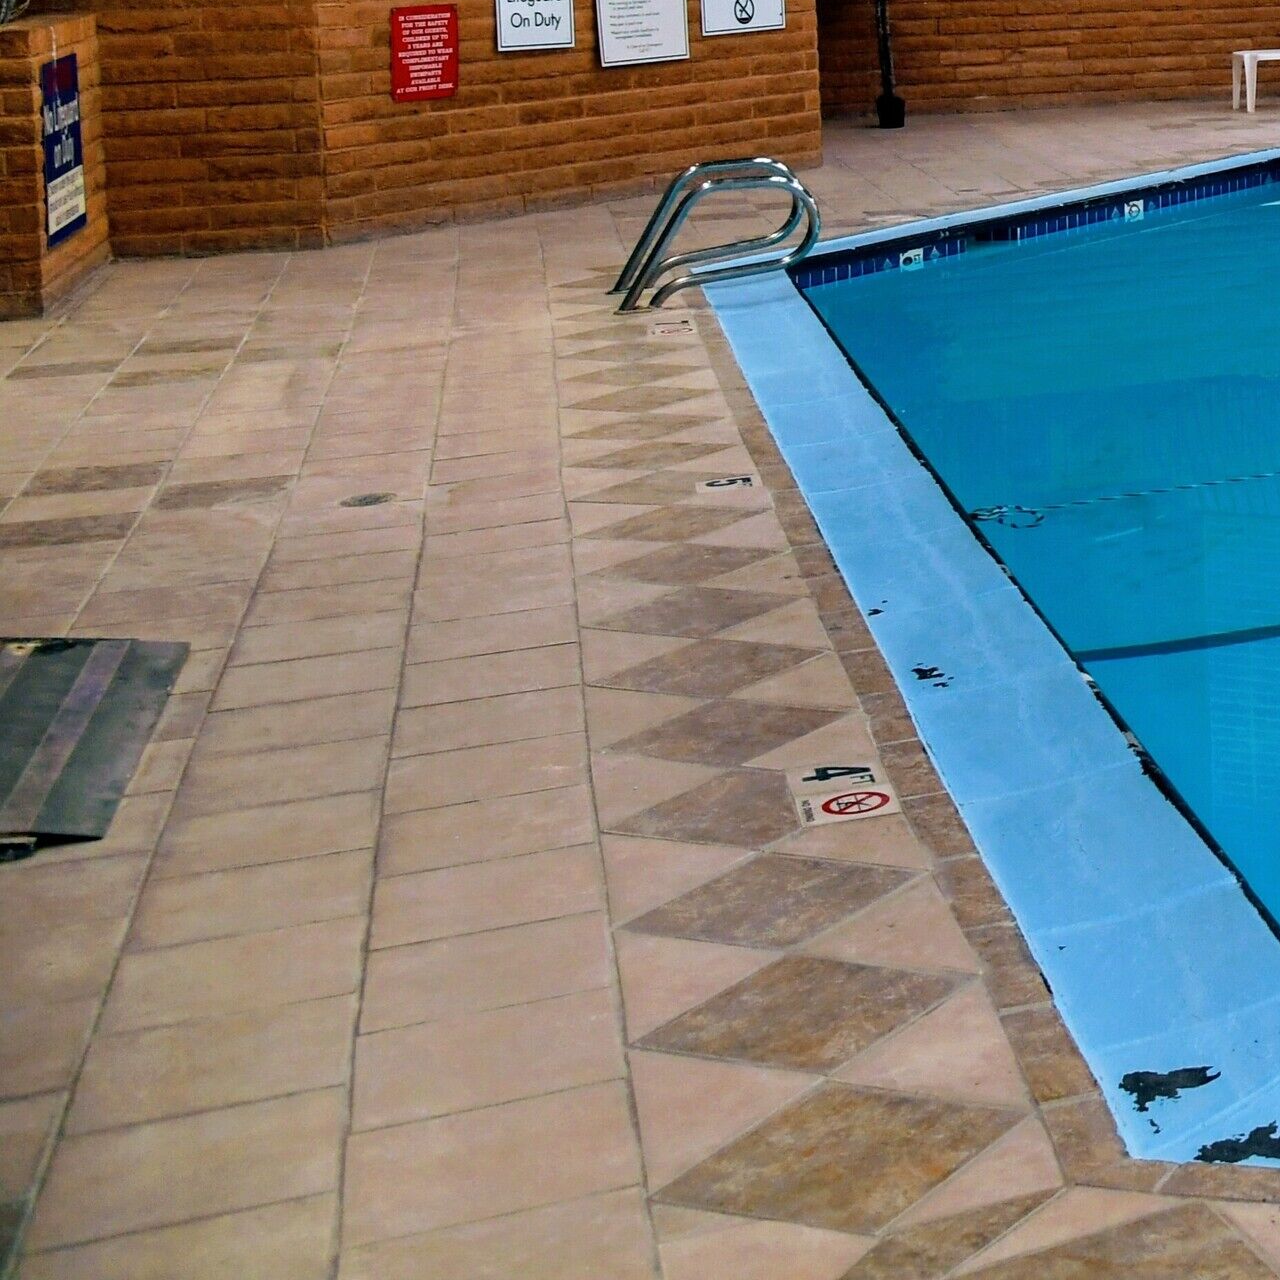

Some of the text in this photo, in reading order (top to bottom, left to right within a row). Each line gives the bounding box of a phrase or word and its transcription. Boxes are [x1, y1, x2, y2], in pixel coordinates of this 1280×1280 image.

[510, 12, 562, 30] On Duty
[402, 35, 431, 43] CHILDREN
[398, 50, 427, 58] REQUIRED
[419, 84, 437, 92] FRONT
[802, 767, 876, 785] 4 FT
